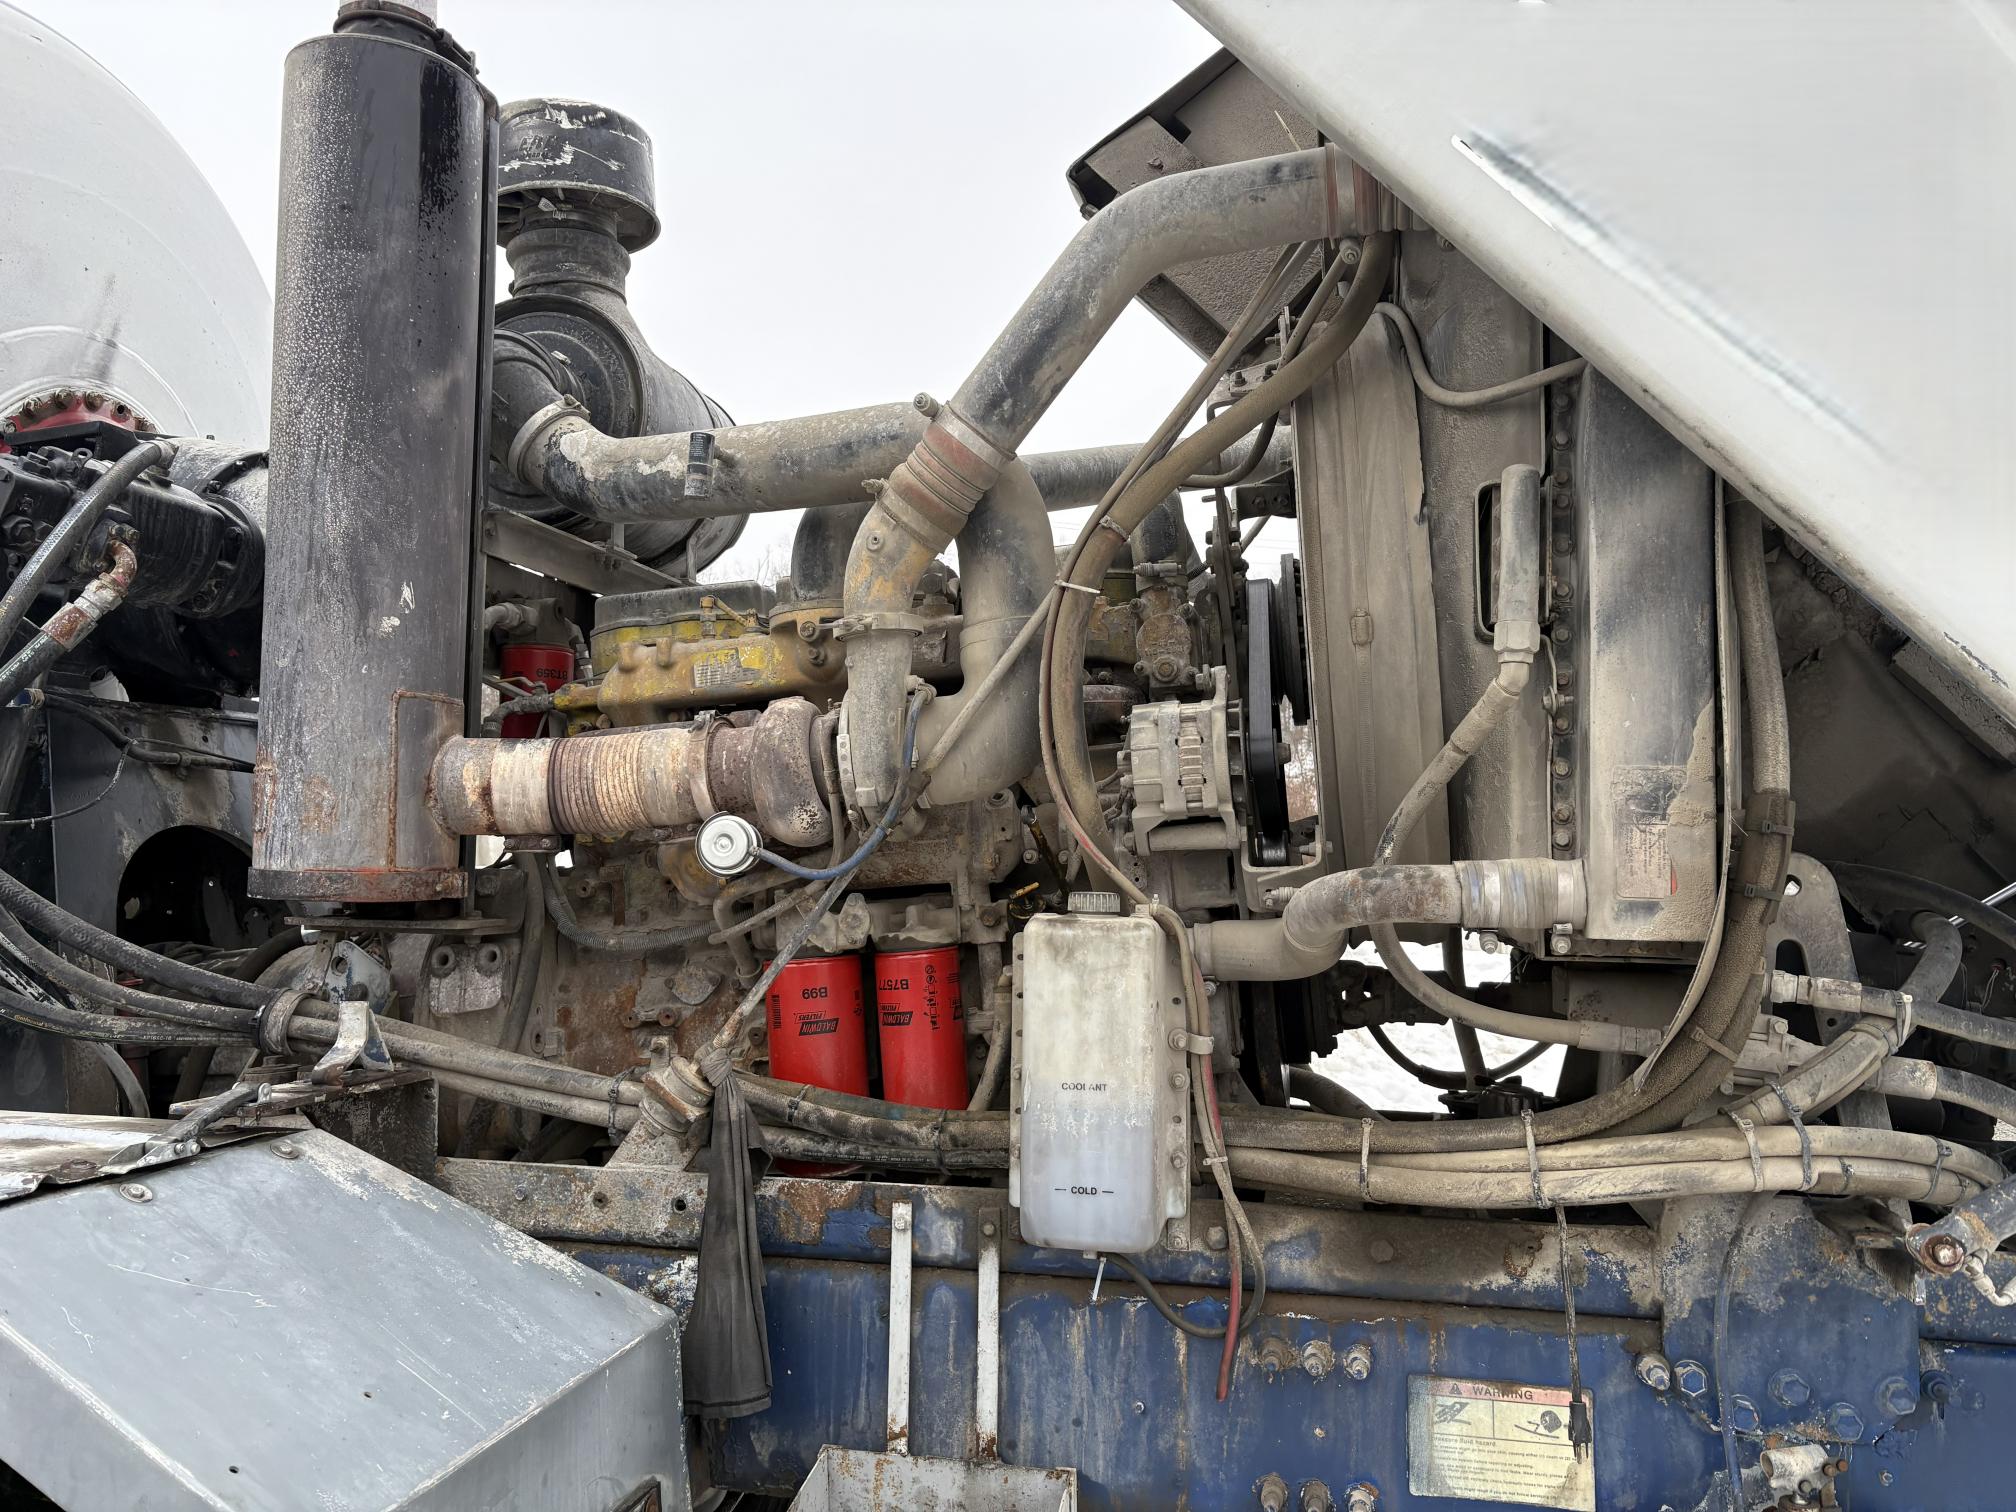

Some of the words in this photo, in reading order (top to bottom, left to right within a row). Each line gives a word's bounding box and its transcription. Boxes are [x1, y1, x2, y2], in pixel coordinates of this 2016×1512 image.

[802, 986, 828, 1000] B99
[801, 1020, 838, 1033] BALDWIN
[1071, 1186, 1098, 1196] COLD
